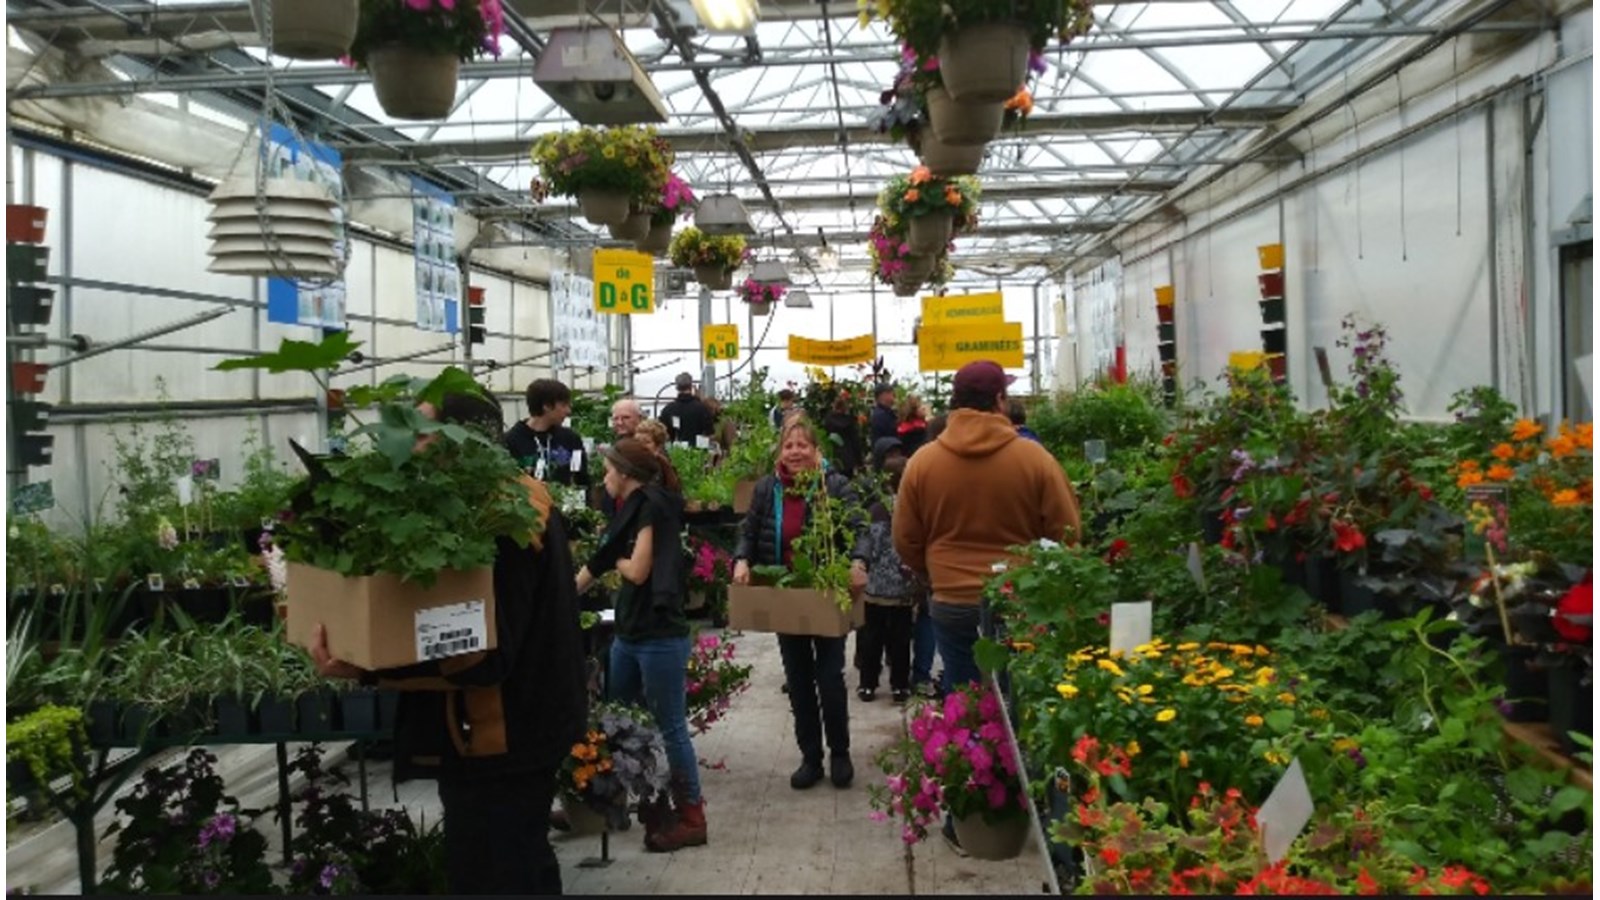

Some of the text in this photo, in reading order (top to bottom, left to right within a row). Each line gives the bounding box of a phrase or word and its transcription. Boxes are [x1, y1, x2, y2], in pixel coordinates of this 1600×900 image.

[599, 281, 616, 308] D
[631, 283, 649, 310] G
[956, 339, 1020, 352] GRAMINÉES
